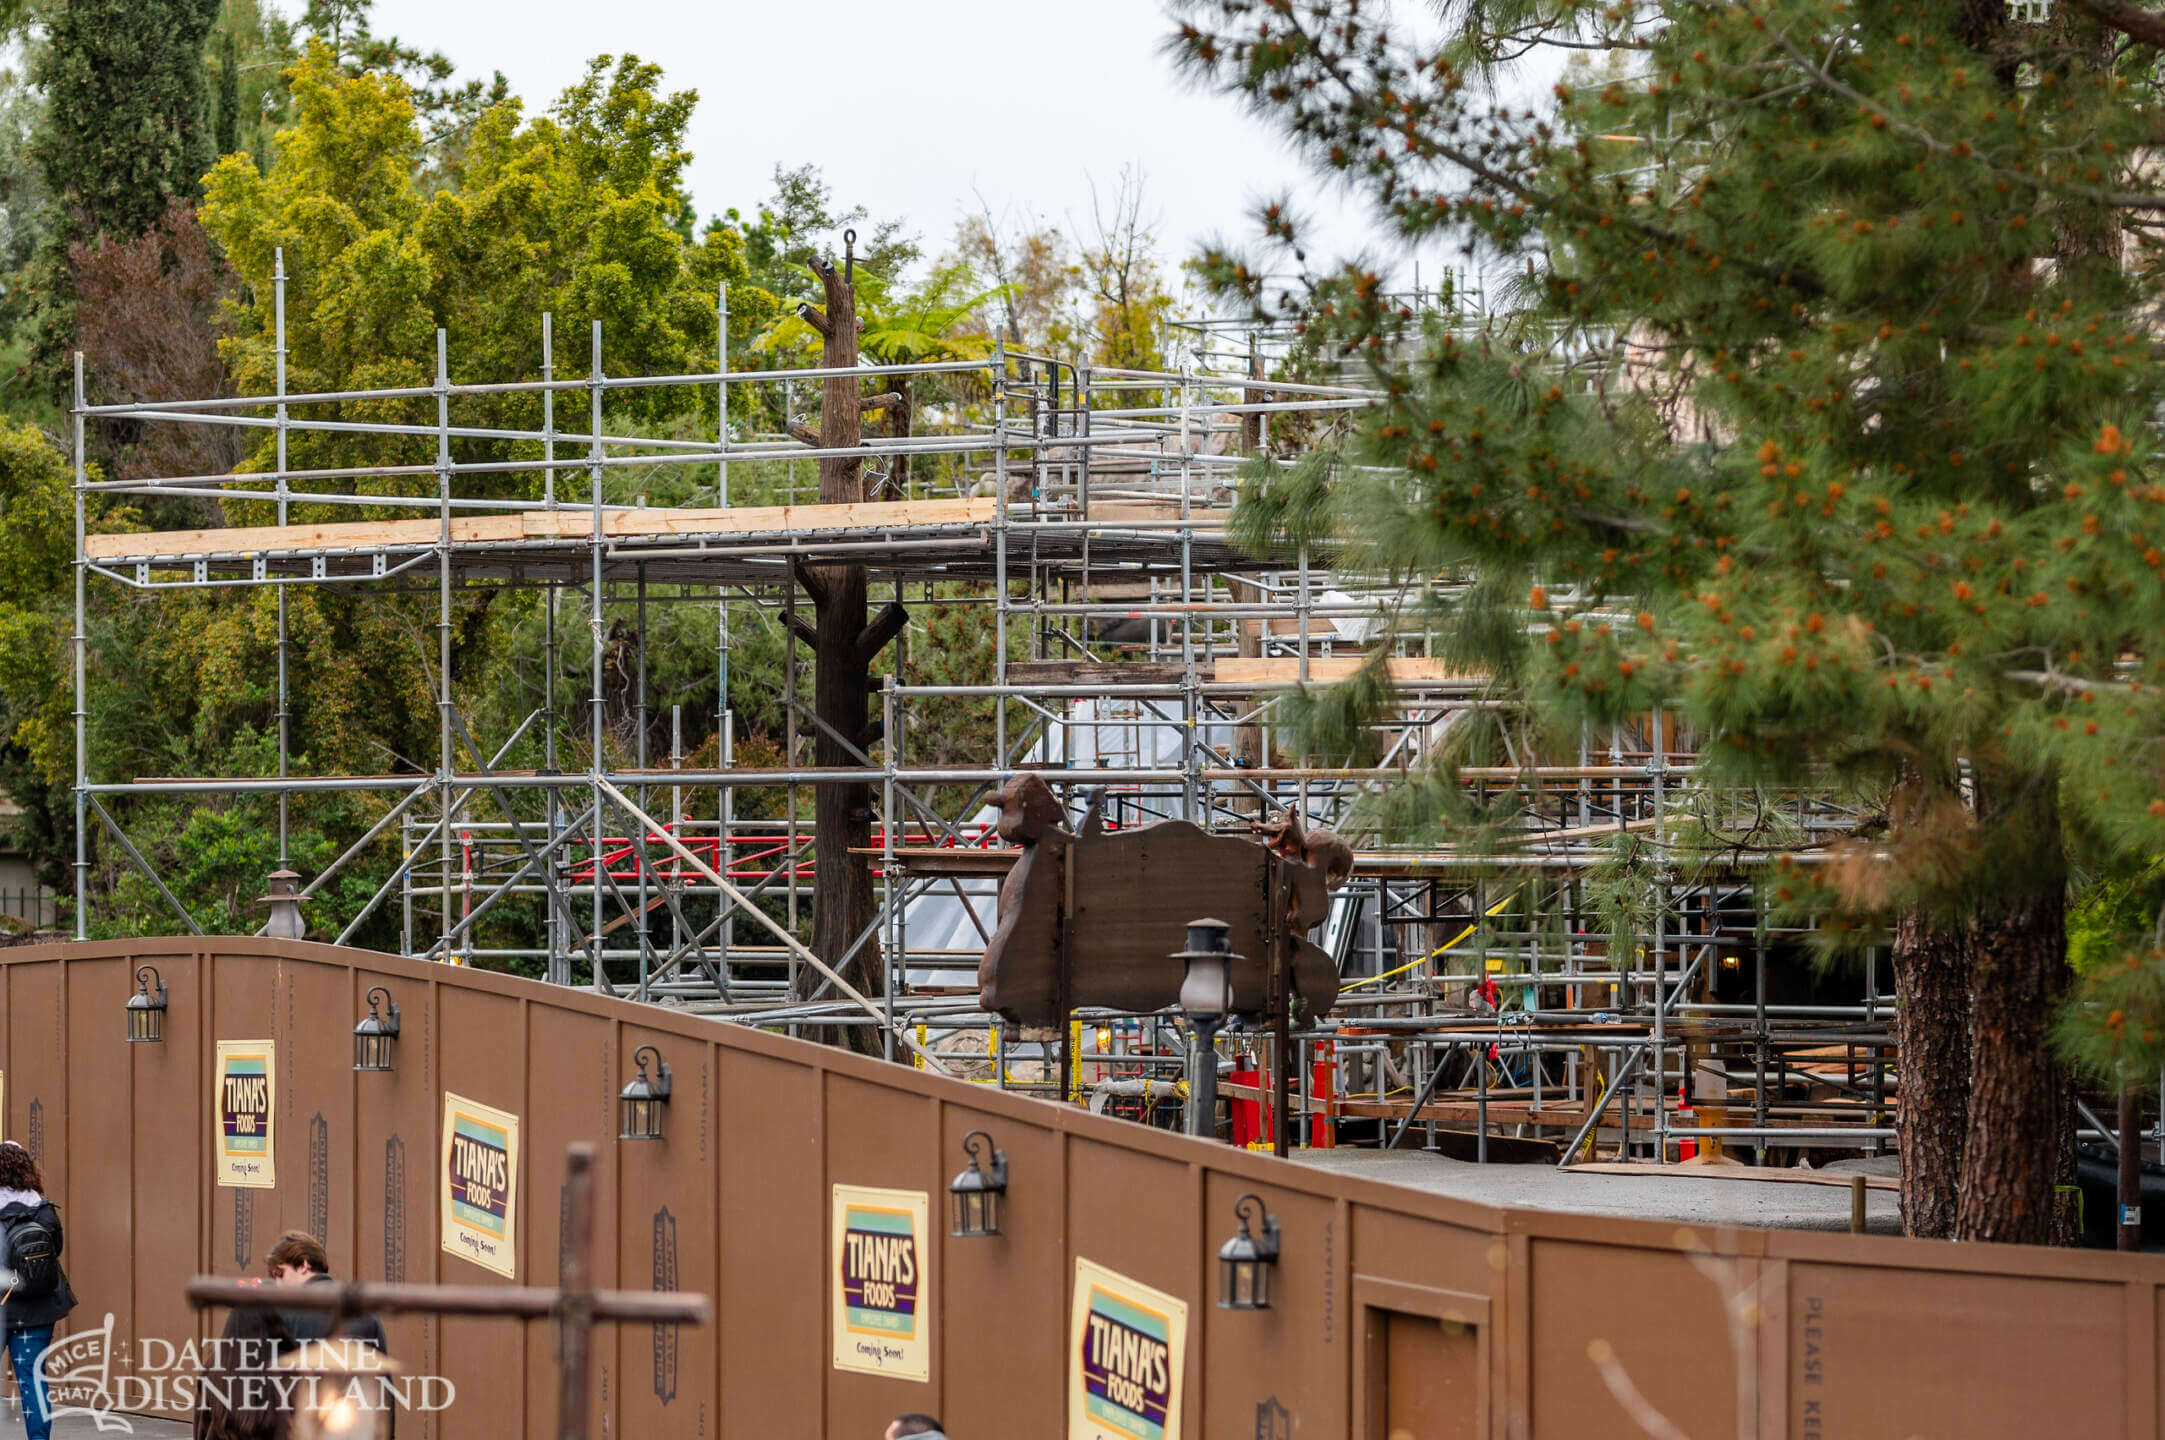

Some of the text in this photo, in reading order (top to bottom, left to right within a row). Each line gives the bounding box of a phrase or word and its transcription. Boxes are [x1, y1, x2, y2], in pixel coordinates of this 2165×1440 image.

[226, 1077, 266, 1113] TIANA'S
[236, 1114, 256, 1133] FOODS
[231, 1161, 247, 1176] Coming
[454, 1137, 506, 1192] TIANA'S
[467, 1181, 491, 1209] FOODS
[460, 1231, 496, 1256] Coming Soon!
[847, 1233, 914, 1285] TIANA'S
[863, 1281, 895, 1308] FOODS
[856, 1342, 904, 1366] Coming Soon!
[1090, 1314, 1166, 1394] TIANA'S
[1804, 1297, 1823, 1385] PLEASE
[1107, 1374, 1145, 1413] FOODS
